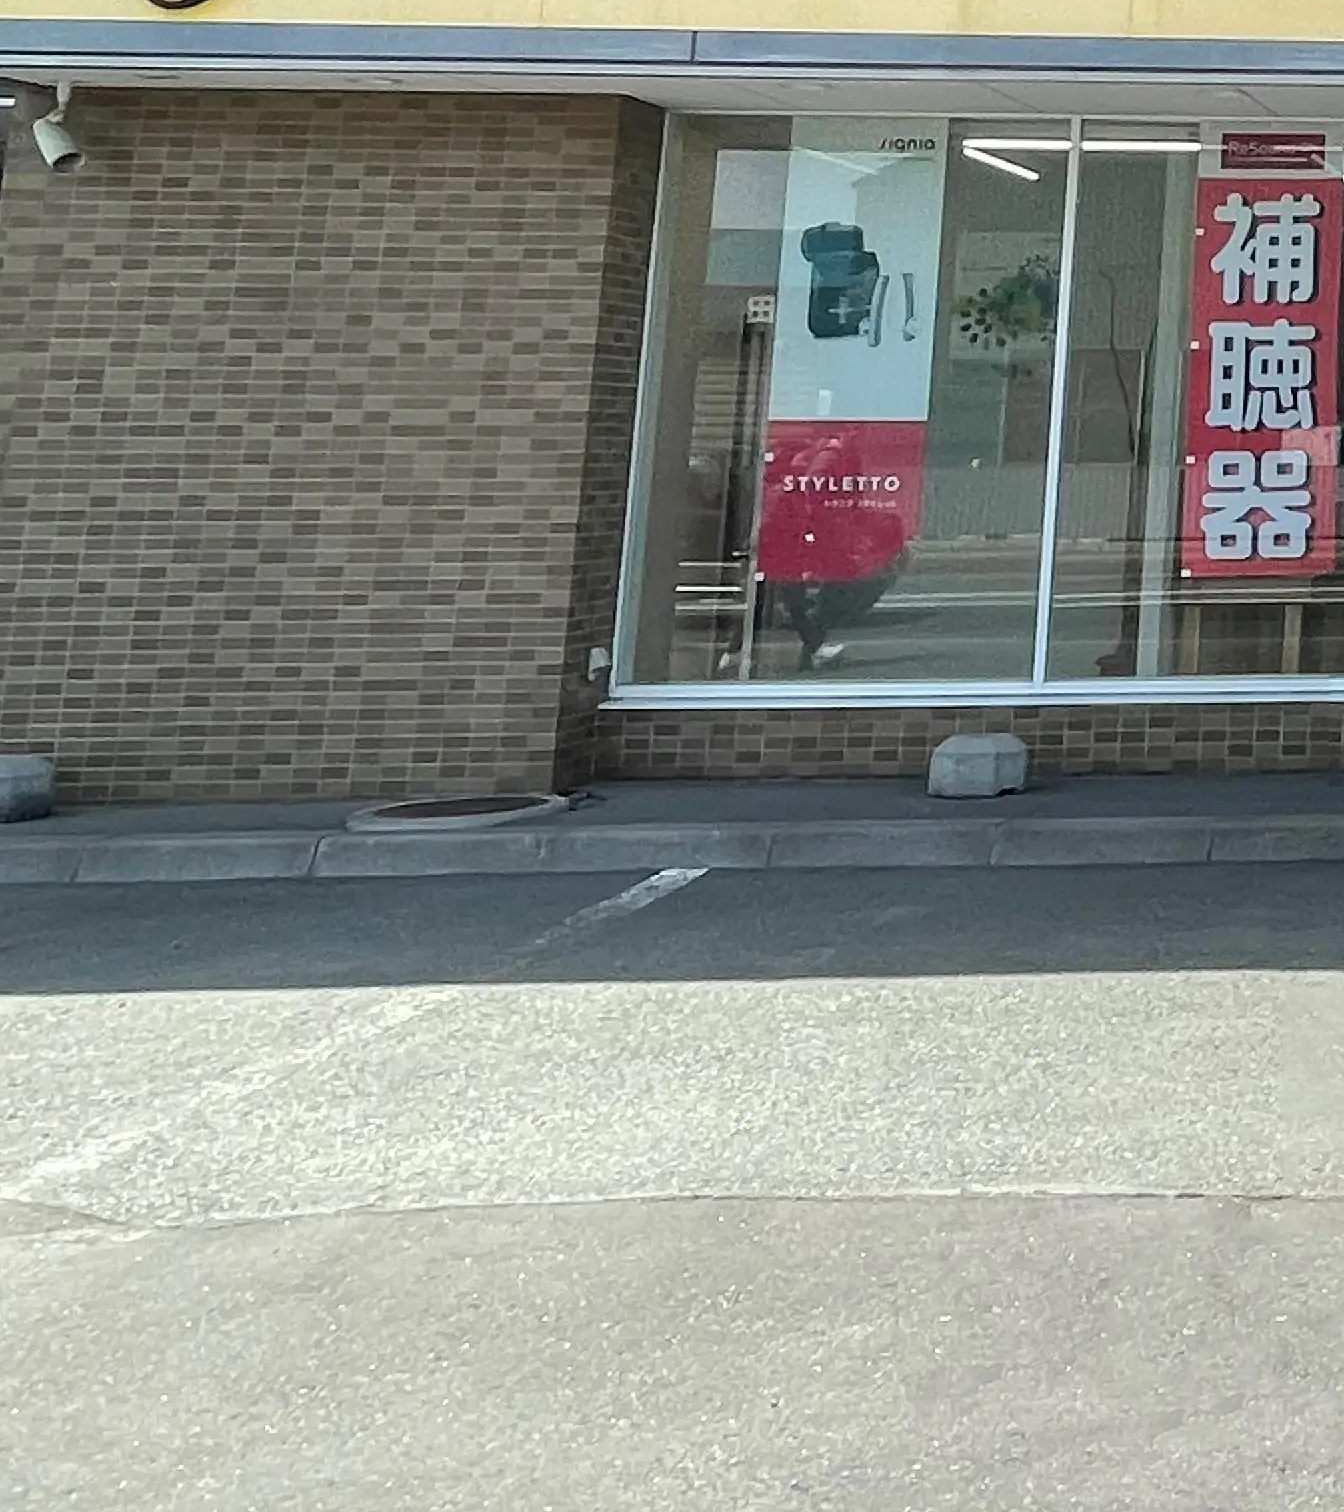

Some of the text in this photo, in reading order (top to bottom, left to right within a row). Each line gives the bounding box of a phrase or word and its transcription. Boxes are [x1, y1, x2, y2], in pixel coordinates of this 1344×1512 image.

[1200, 192, 1321, 561] 補聴器
[782, 474, 901, 493] STYLETTO
